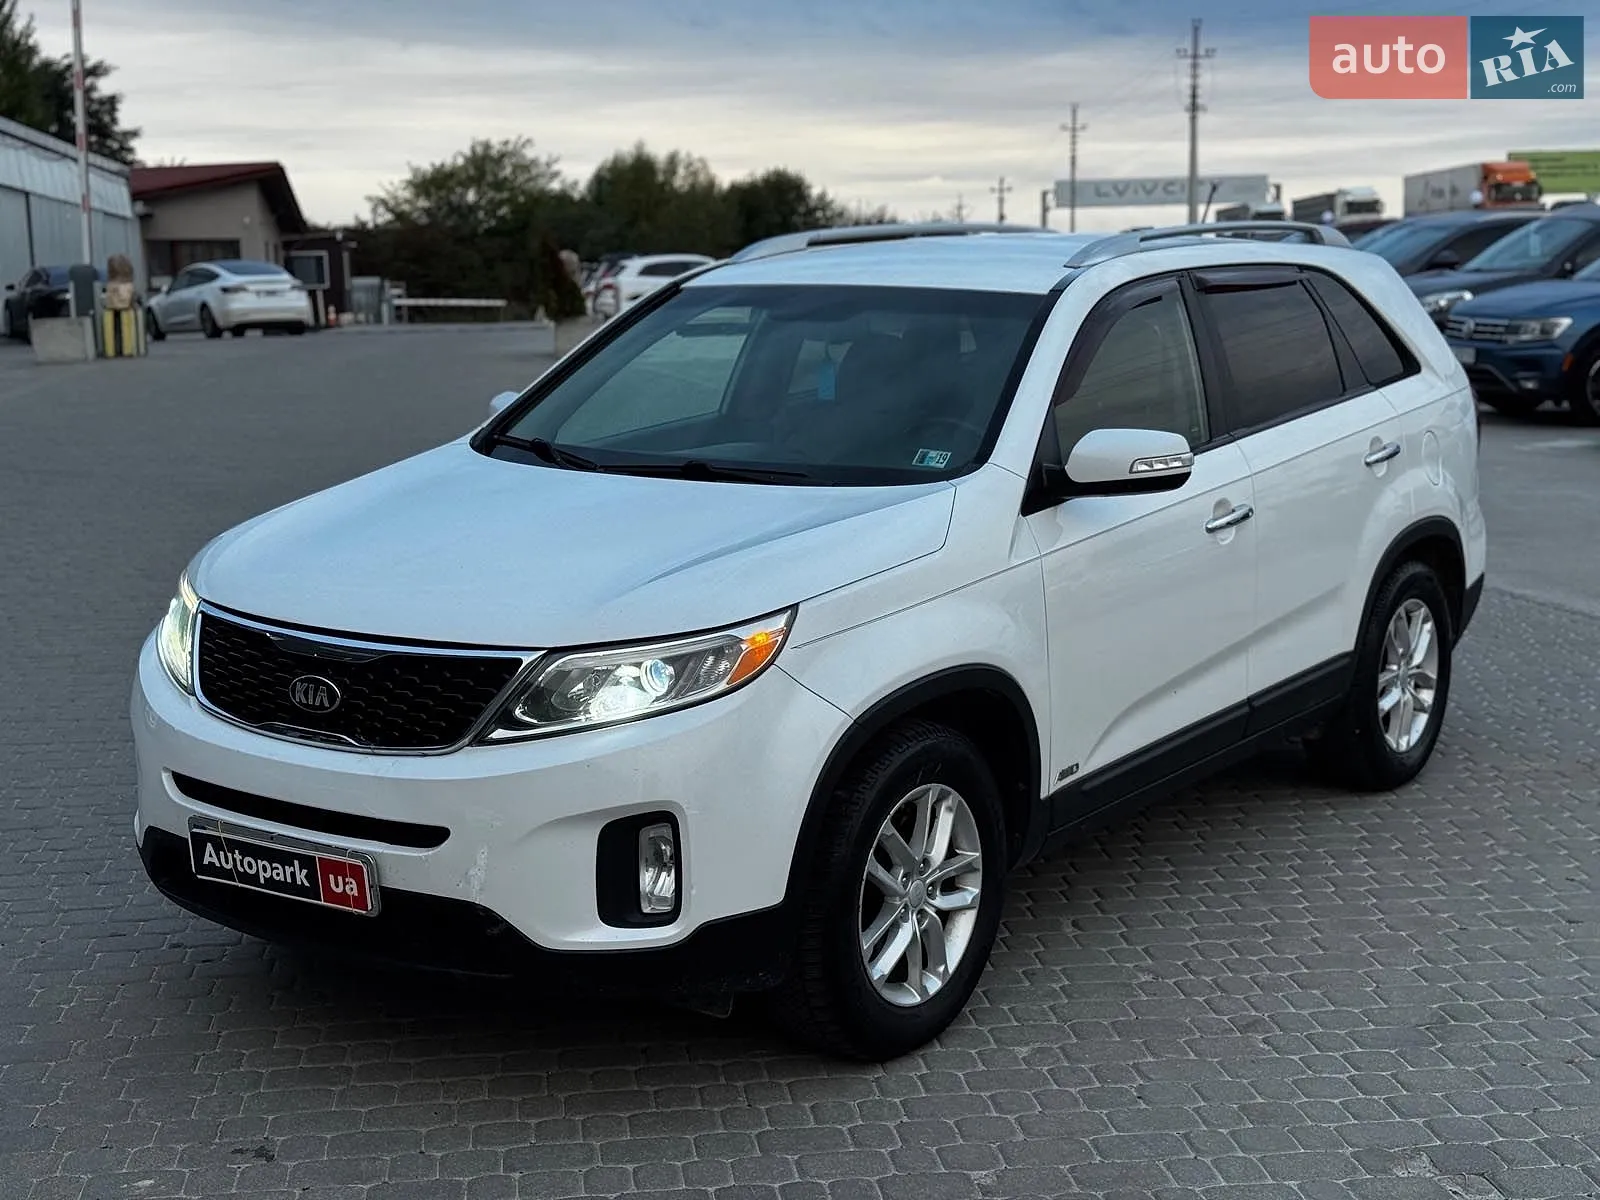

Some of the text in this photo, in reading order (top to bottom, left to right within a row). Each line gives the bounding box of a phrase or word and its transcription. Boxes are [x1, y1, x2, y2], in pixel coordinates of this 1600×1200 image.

[935, 452, 949, 465] 19
[295, 681, 330, 707] KIA
[203, 842, 358, 897] Autopark ua
